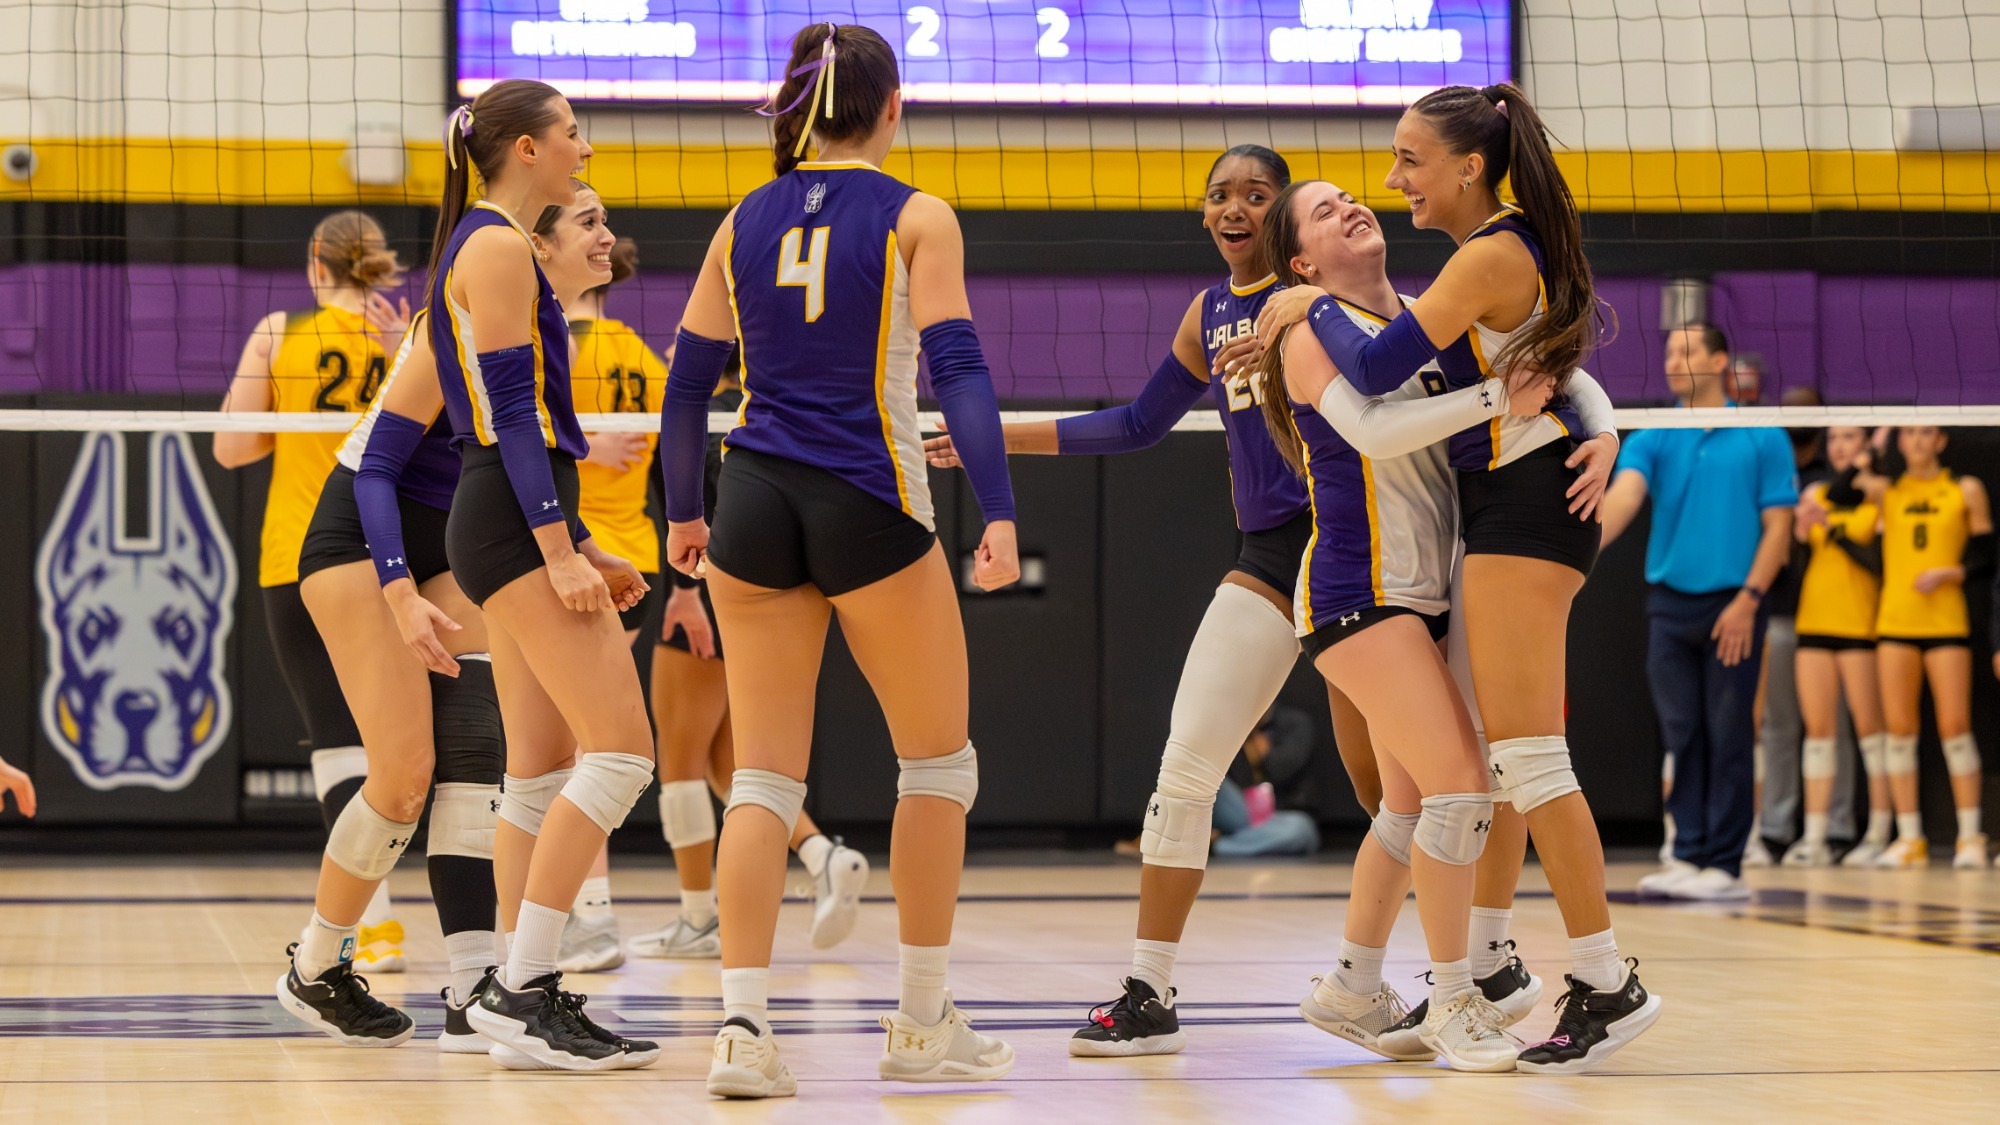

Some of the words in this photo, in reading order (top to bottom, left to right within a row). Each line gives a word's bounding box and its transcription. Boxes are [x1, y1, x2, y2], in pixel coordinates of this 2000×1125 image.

[905, 6, 940, 57] 2
[1035, 7, 1070, 58] 2
[776, 226, 831, 323] 4
[1205, 317, 1258, 350] UALB
[313, 348, 387, 412] 24
